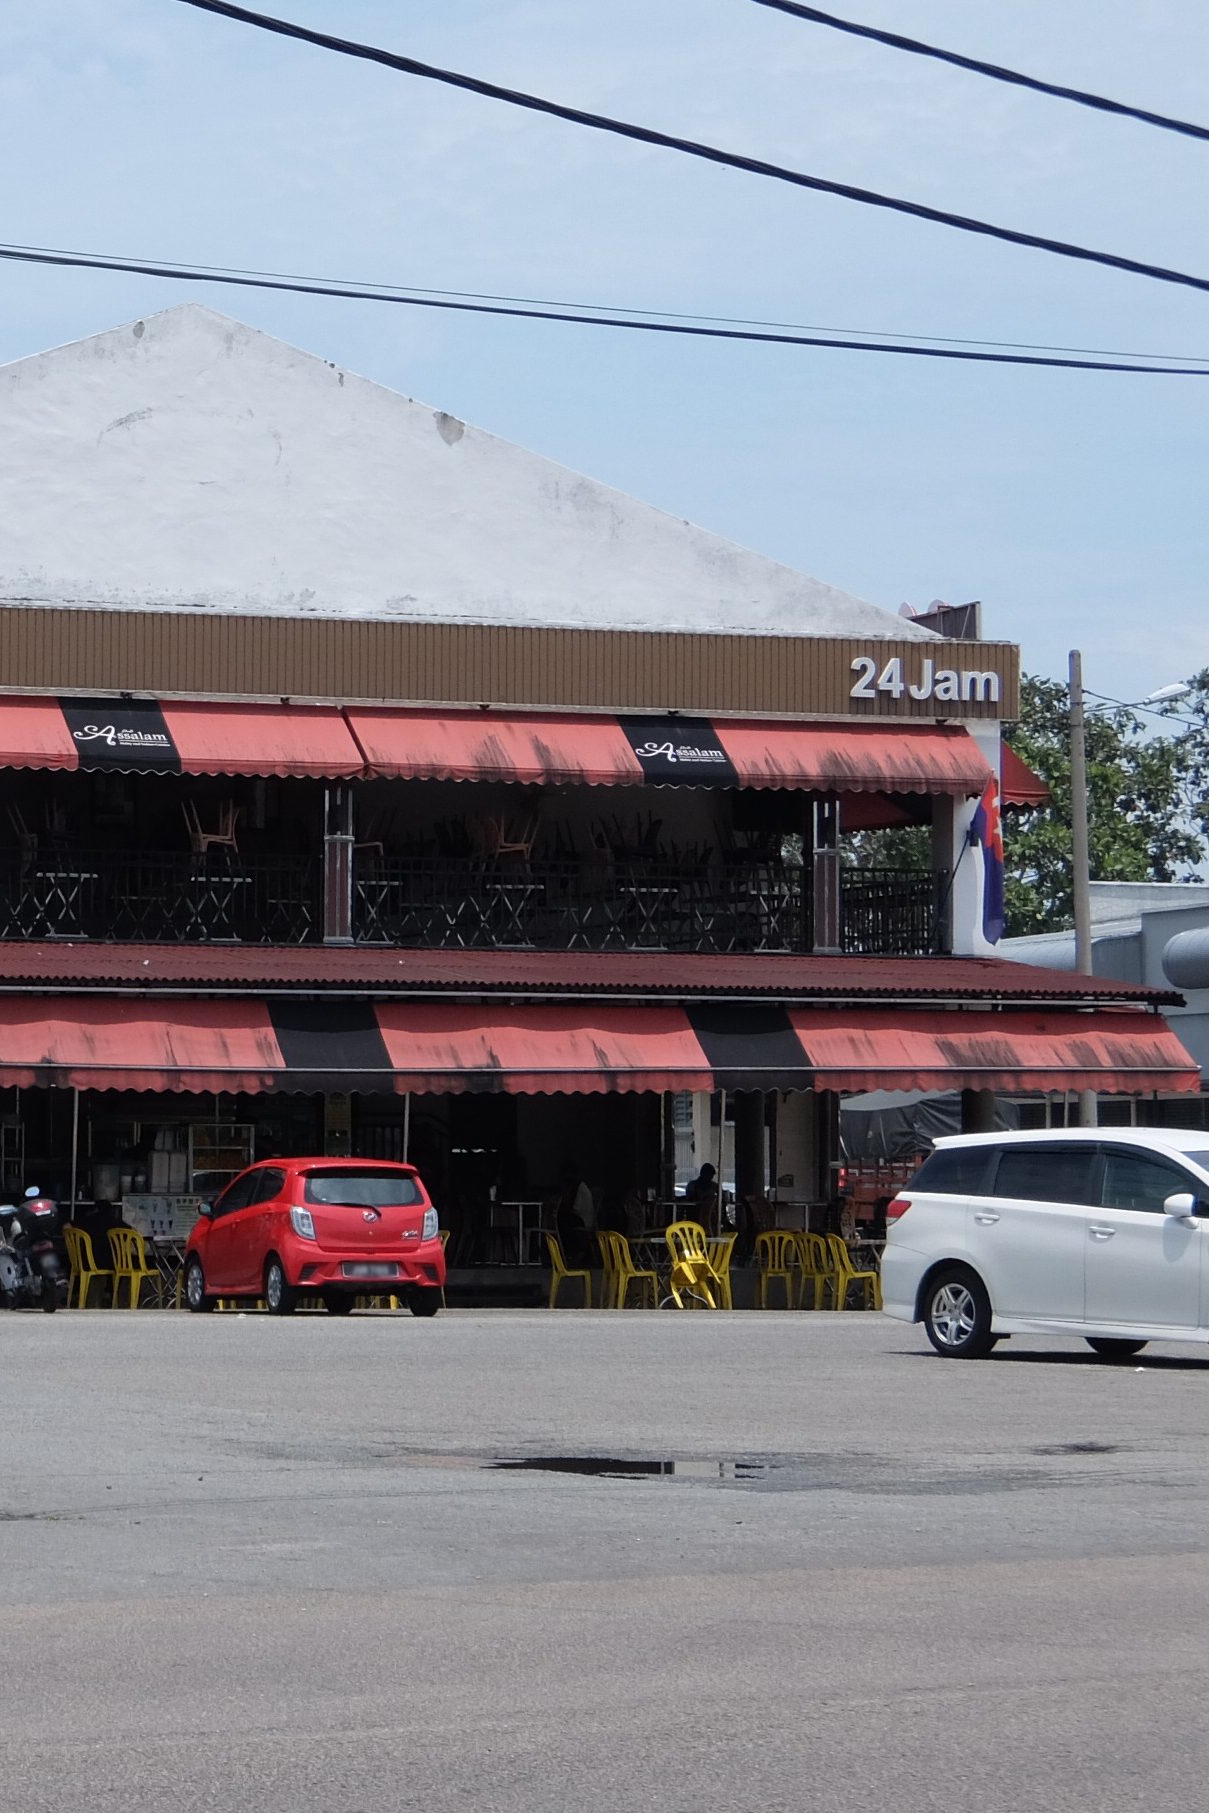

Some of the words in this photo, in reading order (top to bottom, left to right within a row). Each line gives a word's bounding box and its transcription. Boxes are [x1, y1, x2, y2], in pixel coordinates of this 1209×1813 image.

[849, 655, 904, 699] 24
[909, 658, 1000, 703] Jam
[73, 725, 167, 746] Assalam
[635, 742, 724, 763] Assalam
